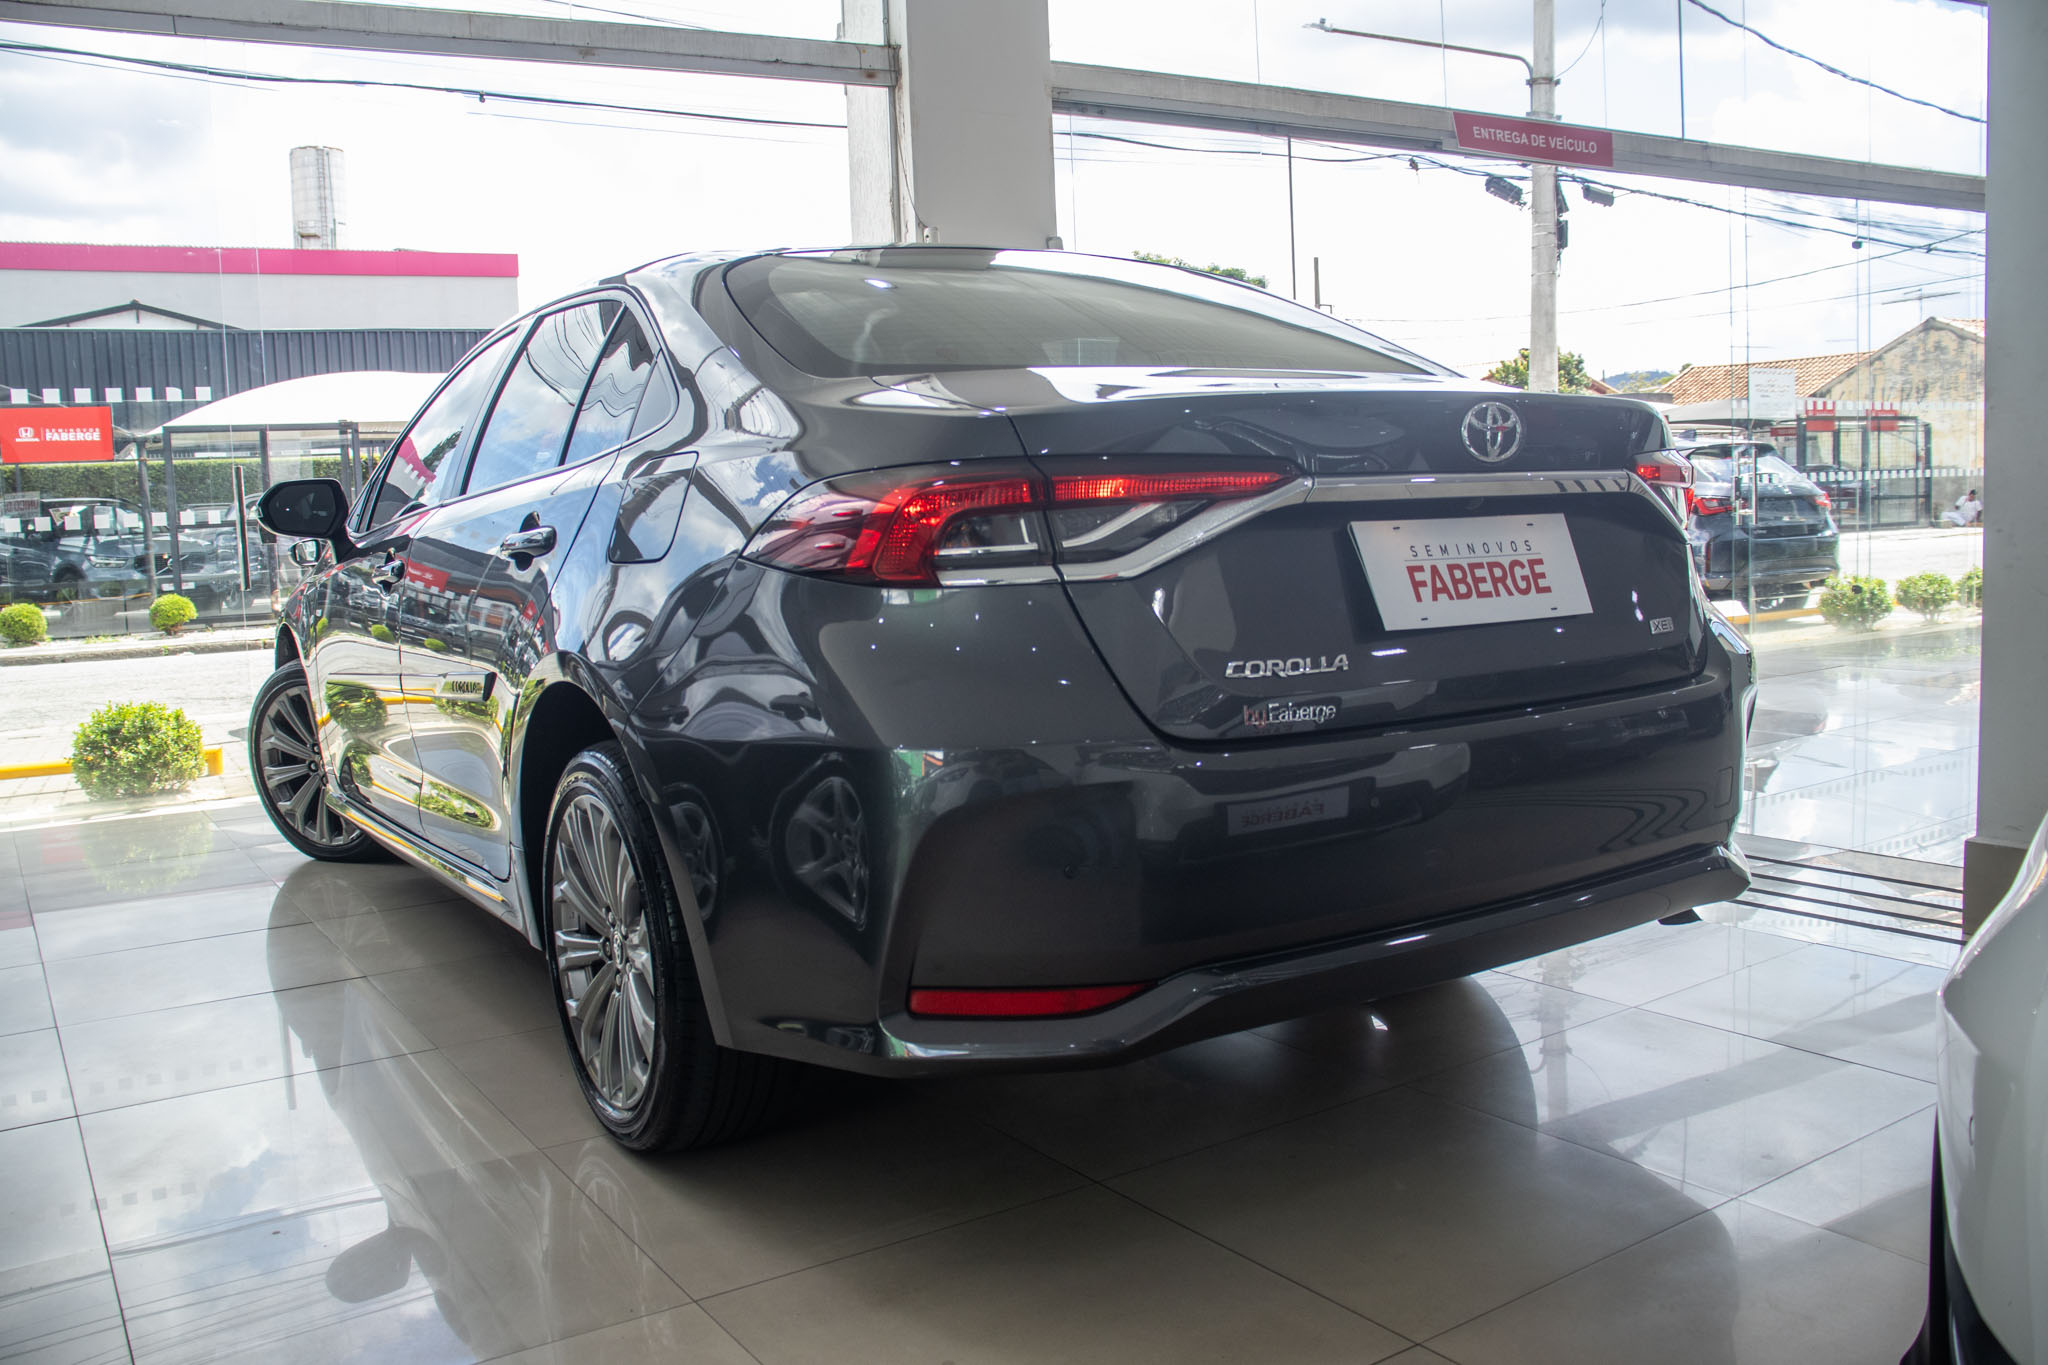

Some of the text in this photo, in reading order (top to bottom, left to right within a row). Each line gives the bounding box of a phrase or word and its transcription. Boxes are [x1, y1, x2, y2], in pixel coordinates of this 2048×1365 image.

[1472, 126, 1598, 154] ENTREGA DE VEÍCULO
[45, 432, 101, 441] FABERGE
[1409, 539, 1533, 558] SEMINOVOS
[1406, 558, 1553, 603] FABERGE
[1225, 653, 1349, 678] COROLLA
[1243, 702, 1337, 728] by Faberge
